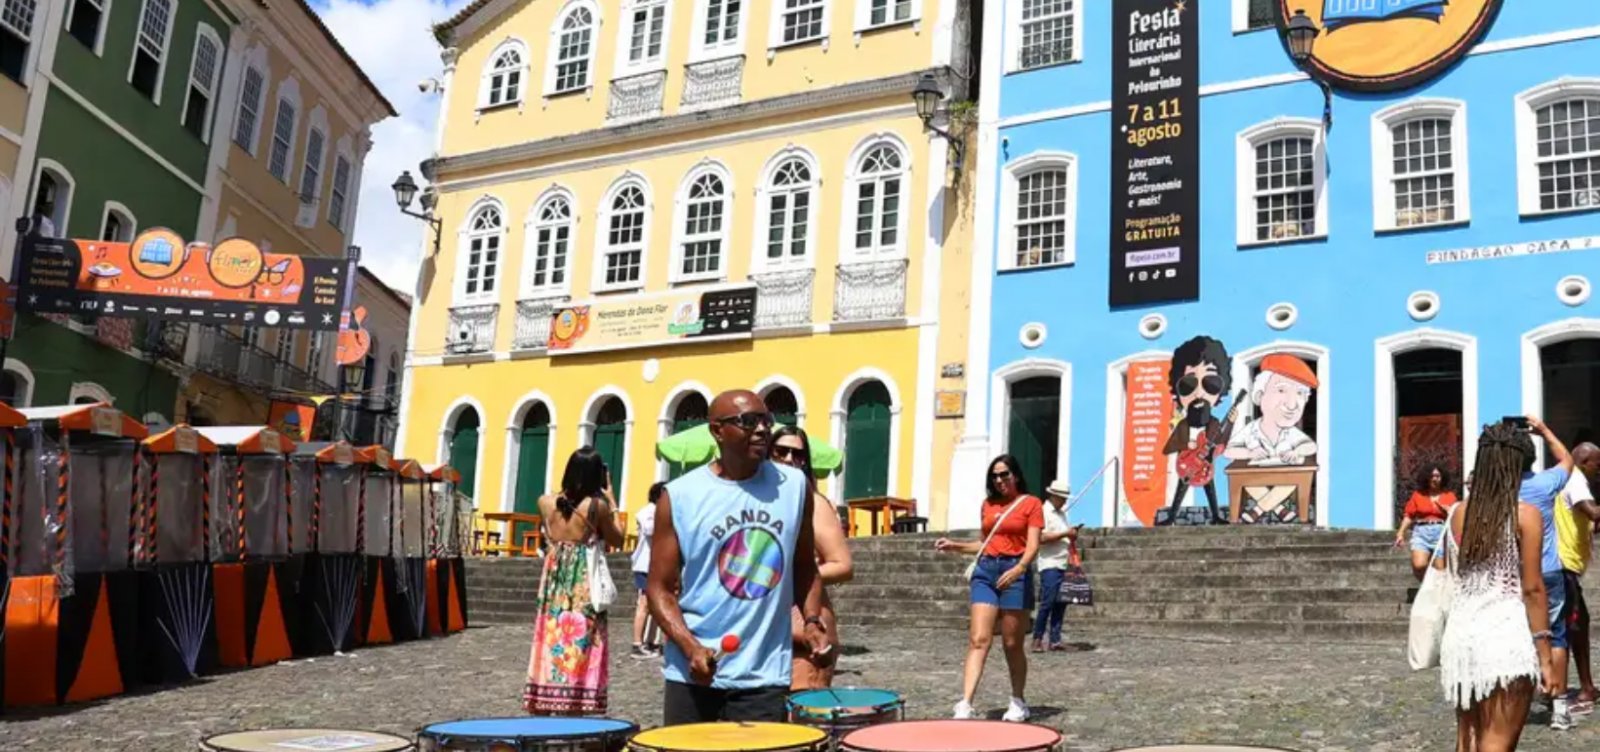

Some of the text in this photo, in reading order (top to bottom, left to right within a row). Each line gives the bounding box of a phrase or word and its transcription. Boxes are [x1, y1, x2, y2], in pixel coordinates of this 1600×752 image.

[1129, 7, 1181, 36] Festa
[1129, 31, 1181, 54] Literária
[1129, 49, 1182, 68] Internacional
[1149, 67, 1160, 77] do
[1128, 76, 1182, 95] Pelourinho
[1128, 97, 1181, 124] 7 a 11
[1127, 121, 1181, 147] agosto
[1128, 171, 1149, 182] Arte,
[1128, 178, 1182, 195] Gastronomia
[1128, 194, 1162, 208] e mais!
[1125, 213, 1181, 229] Programação
[1125, 226, 1181, 242] GRATUITA
[710, 509, 784, 541] BANDA
